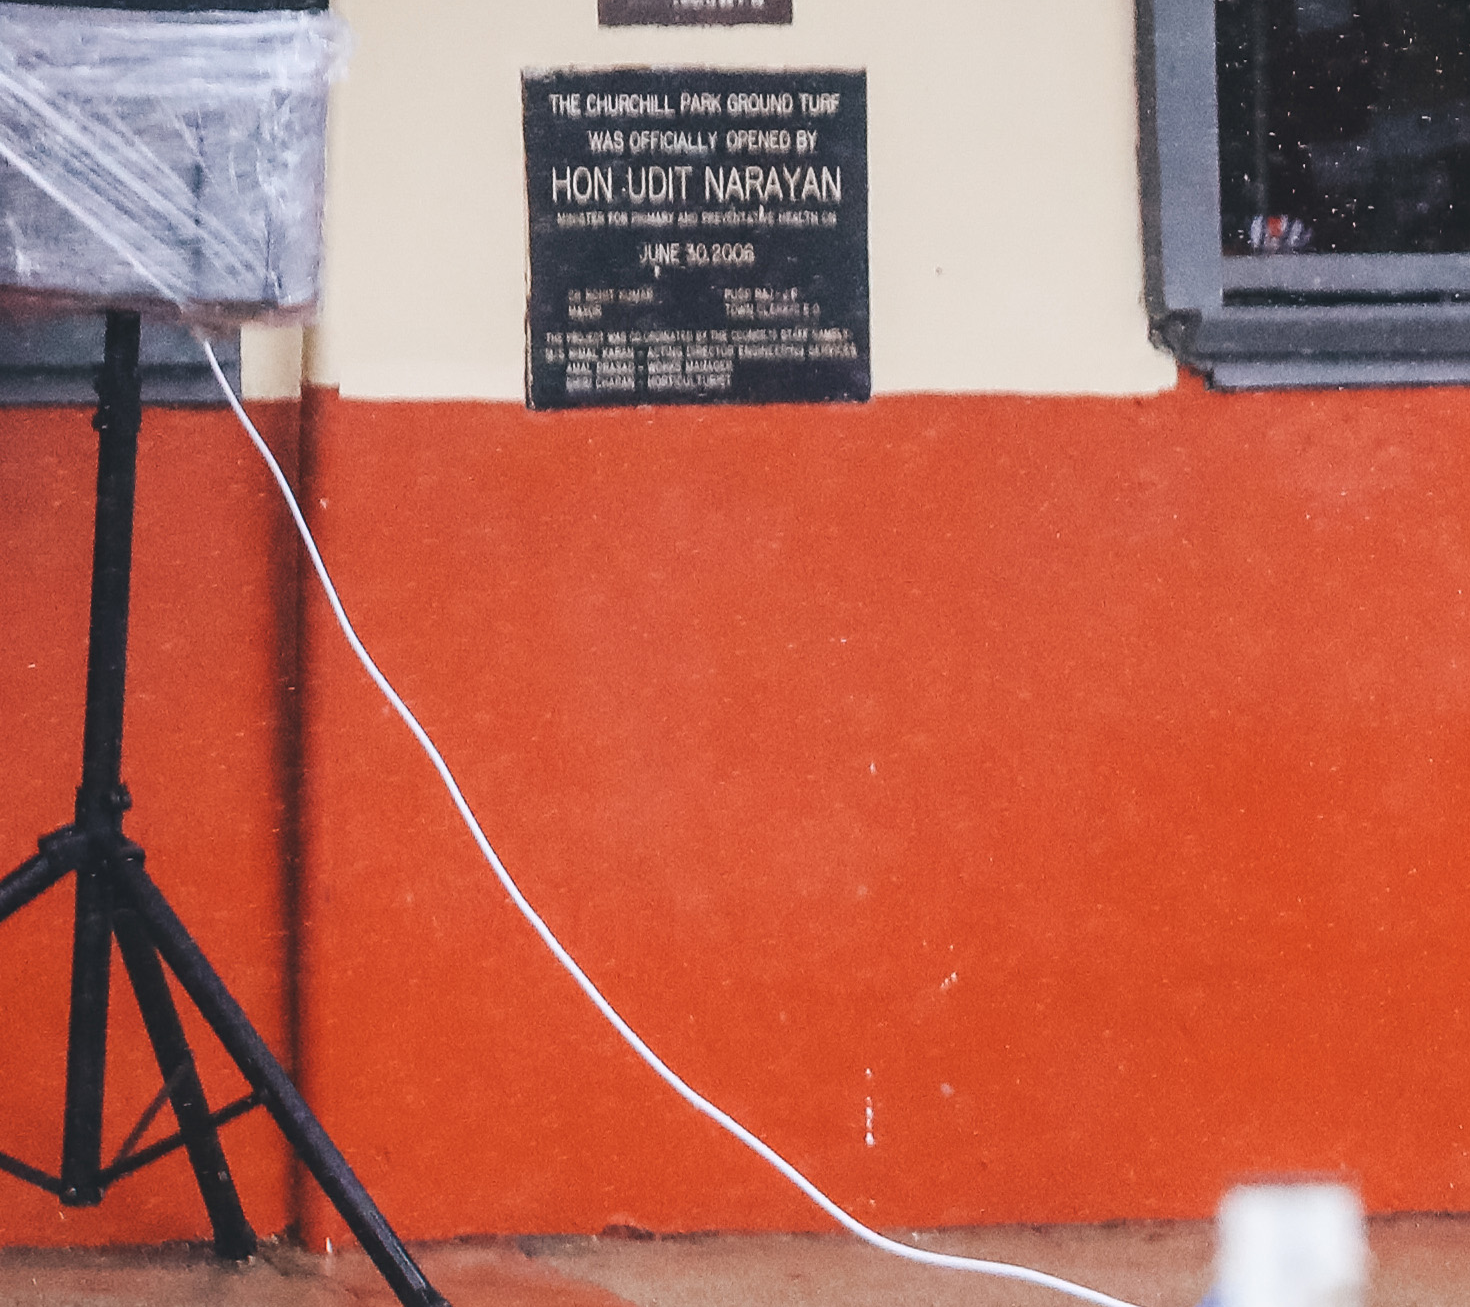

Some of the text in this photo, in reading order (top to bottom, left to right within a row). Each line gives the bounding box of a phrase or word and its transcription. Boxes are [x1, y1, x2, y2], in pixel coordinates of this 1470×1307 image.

[551, 93, 840, 118] THE CHURCHILL PARK GROUND TURF
[587, 130, 818, 155] WAS OFFICIALLY OPENED BY
[628, 166, 693, 204] UDIT
[704, 166, 842, 204] NARAYAN
[640, 243, 681, 265] JUNE
